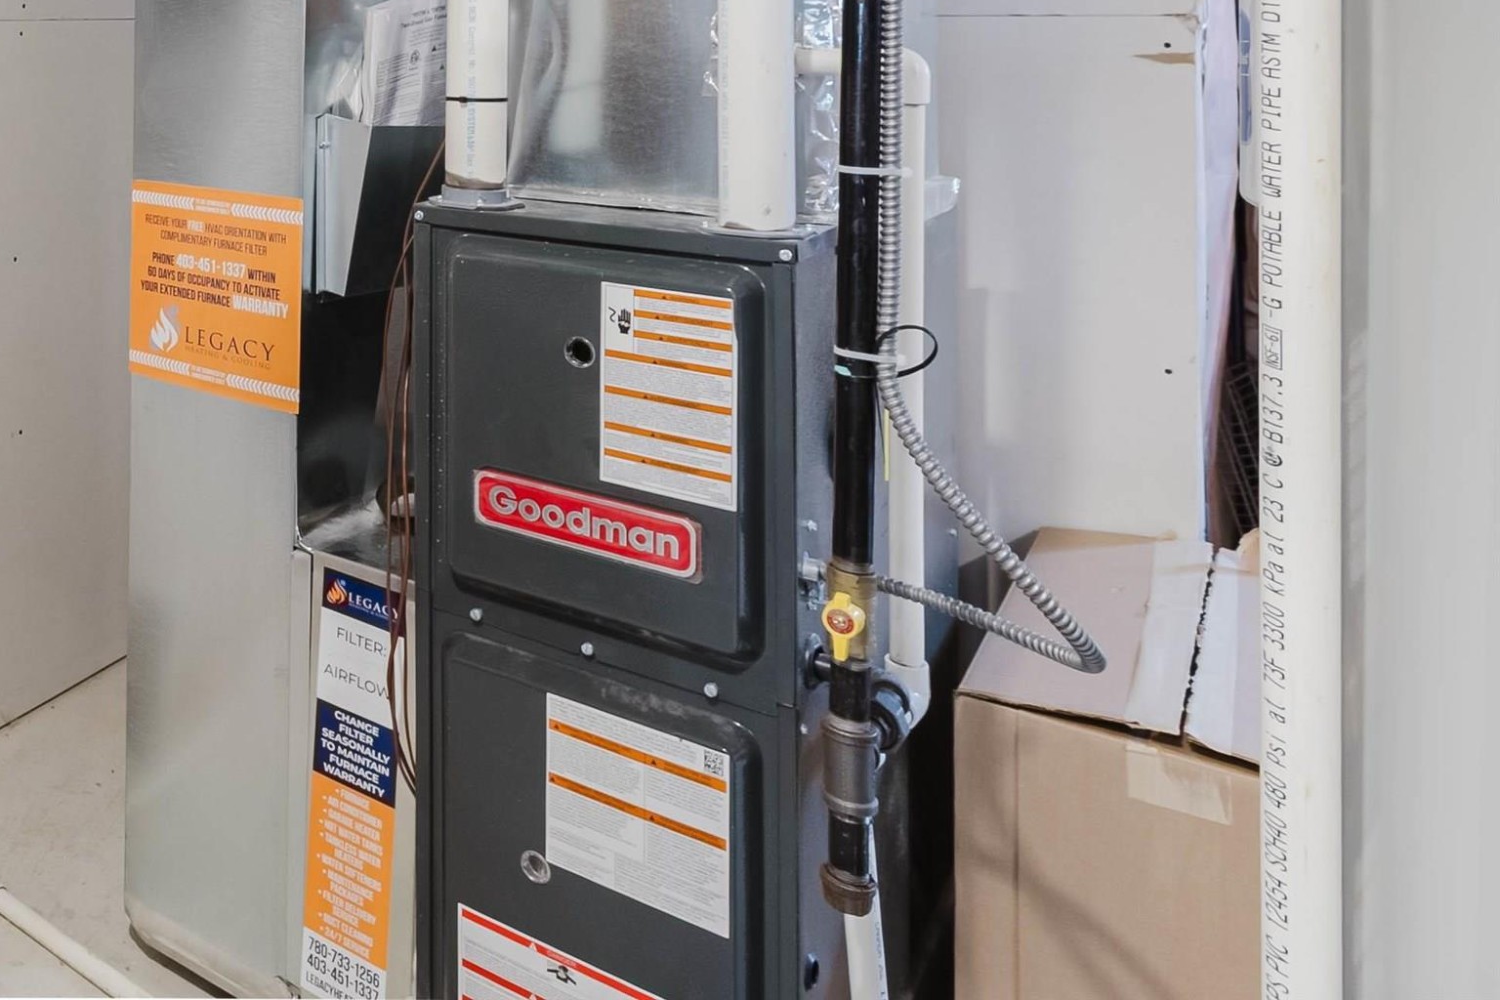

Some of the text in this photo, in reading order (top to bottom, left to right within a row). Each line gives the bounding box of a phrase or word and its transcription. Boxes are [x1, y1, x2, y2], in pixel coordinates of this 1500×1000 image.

[1262, 33, 1280, 80] ASTM
[1262, 84, 1281, 131] PIPE
[1262, 142, 1281, 198] WATER
[145, 213, 169, 227] RECEIVE
[171, 218, 188, 229] YOUR
[205, 222, 223, 235] HVAC
[224, 225, 267, 241] ORIENTATION
[268, 232, 287, 244] WITH
[160, 229, 267, 256] COMPLIMENTARY FURNACE FILTER
[152, 251, 175, 266] PHONE
[247, 268, 276, 283] WITHIN
[1262, 208, 1281, 288] POTABLE
[140, 279, 289, 319] YOUR EXTENDED FURNACE WARRANTY
[158, 267, 176, 281] DAYS
[177, 271, 186, 282] OF
[187, 273, 231, 291] OCCUPANCY
[232, 281, 242, 293] TO
[243, 283, 281, 300] ACTIVATE
[185, 326, 275, 361] LEGACY
[1262, 373, 1283, 445] B137.3
[1262, 473, 1283, 489] C
[488, 484, 680, 560] Goodman
[1262, 495, 1283, 523] 23
[1263, 561, 1284, 597] kPa
[336, 627, 387, 657] FILTER:
[1263, 600, 1285, 651] 3300
[1263, 650, 1285, 689] 73F
[334, 710, 380, 737] CHANGE
[338, 723, 374, 746] FILTER
[321, 727, 390, 765] SEASONALLY
[321, 737, 390, 777] TO MAINTAIN
[323, 762, 385, 798] WARRANTY
[329, 753, 380, 784] FURNACE
[1264, 770, 1286, 808] 480
[1264, 809, 1287, 872] SCH40
[1265, 870, 1288, 931] 12454
[308, 935, 380, 988] 780-733-1256
[1266, 934, 1289, 978] PVC
[307, 953, 379, 1000] 403-451-1337
